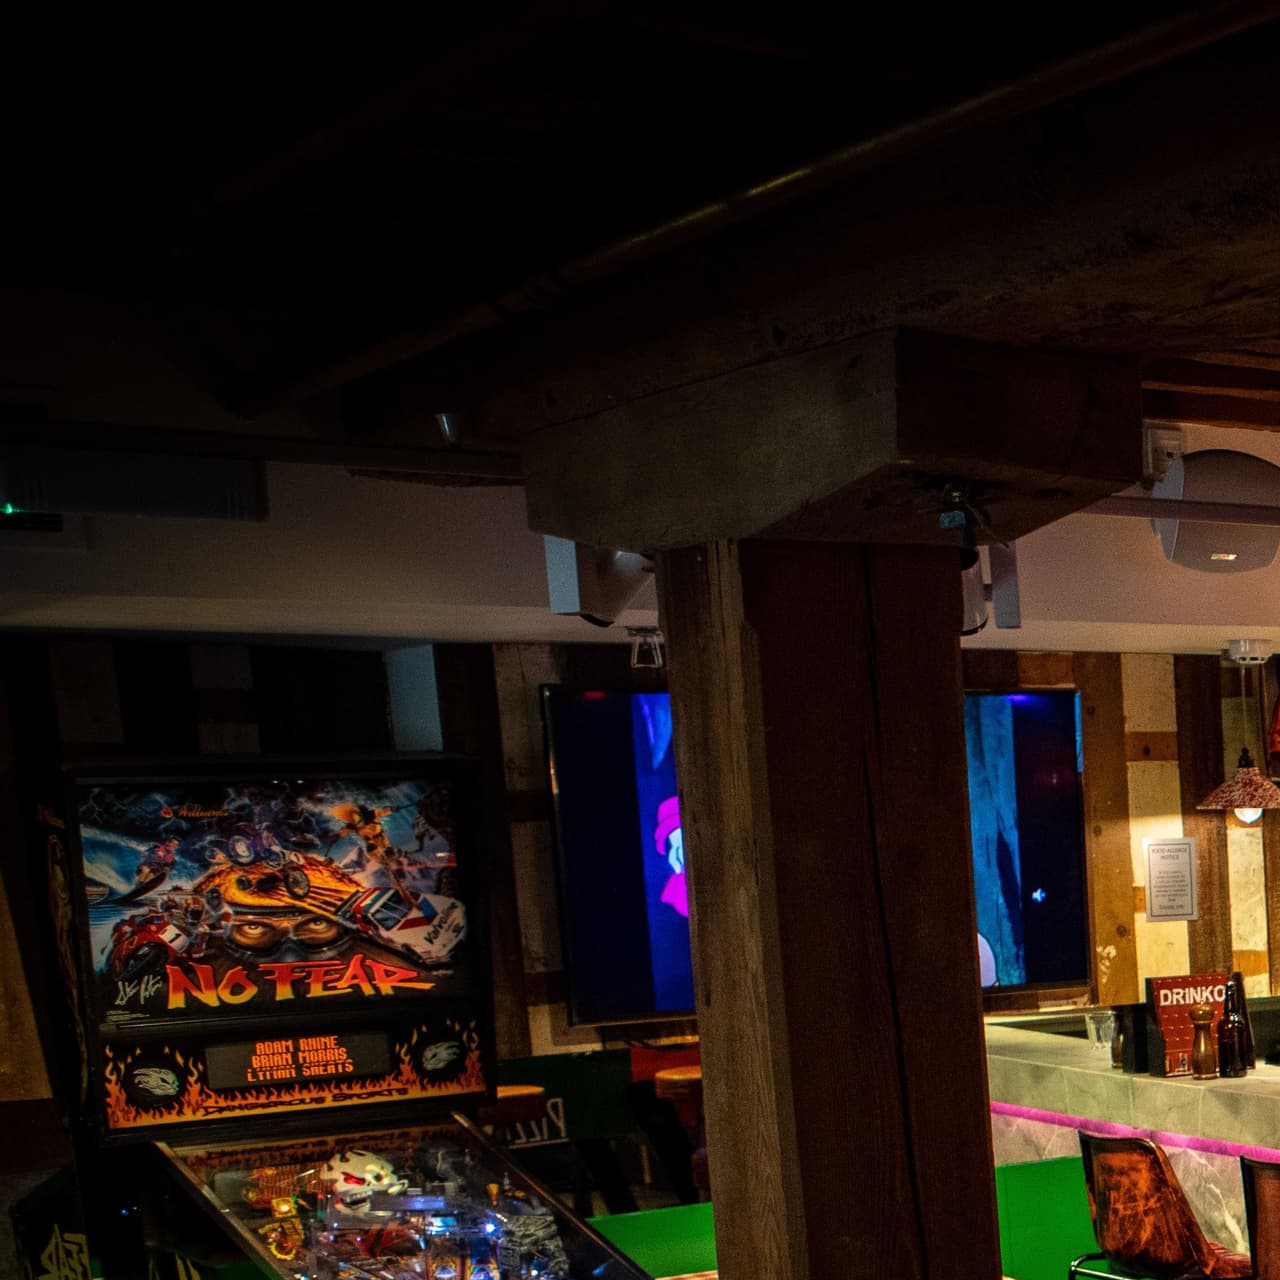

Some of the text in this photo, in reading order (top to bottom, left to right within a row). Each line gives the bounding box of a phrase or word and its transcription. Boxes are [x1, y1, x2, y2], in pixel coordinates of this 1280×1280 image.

[165, 961, 259, 1011] NO
[257, 952, 437, 1003] FEAR
[251, 1046, 349, 1070] BRIAN MORRIS
[255, 1039, 294, 1054] ADAM
